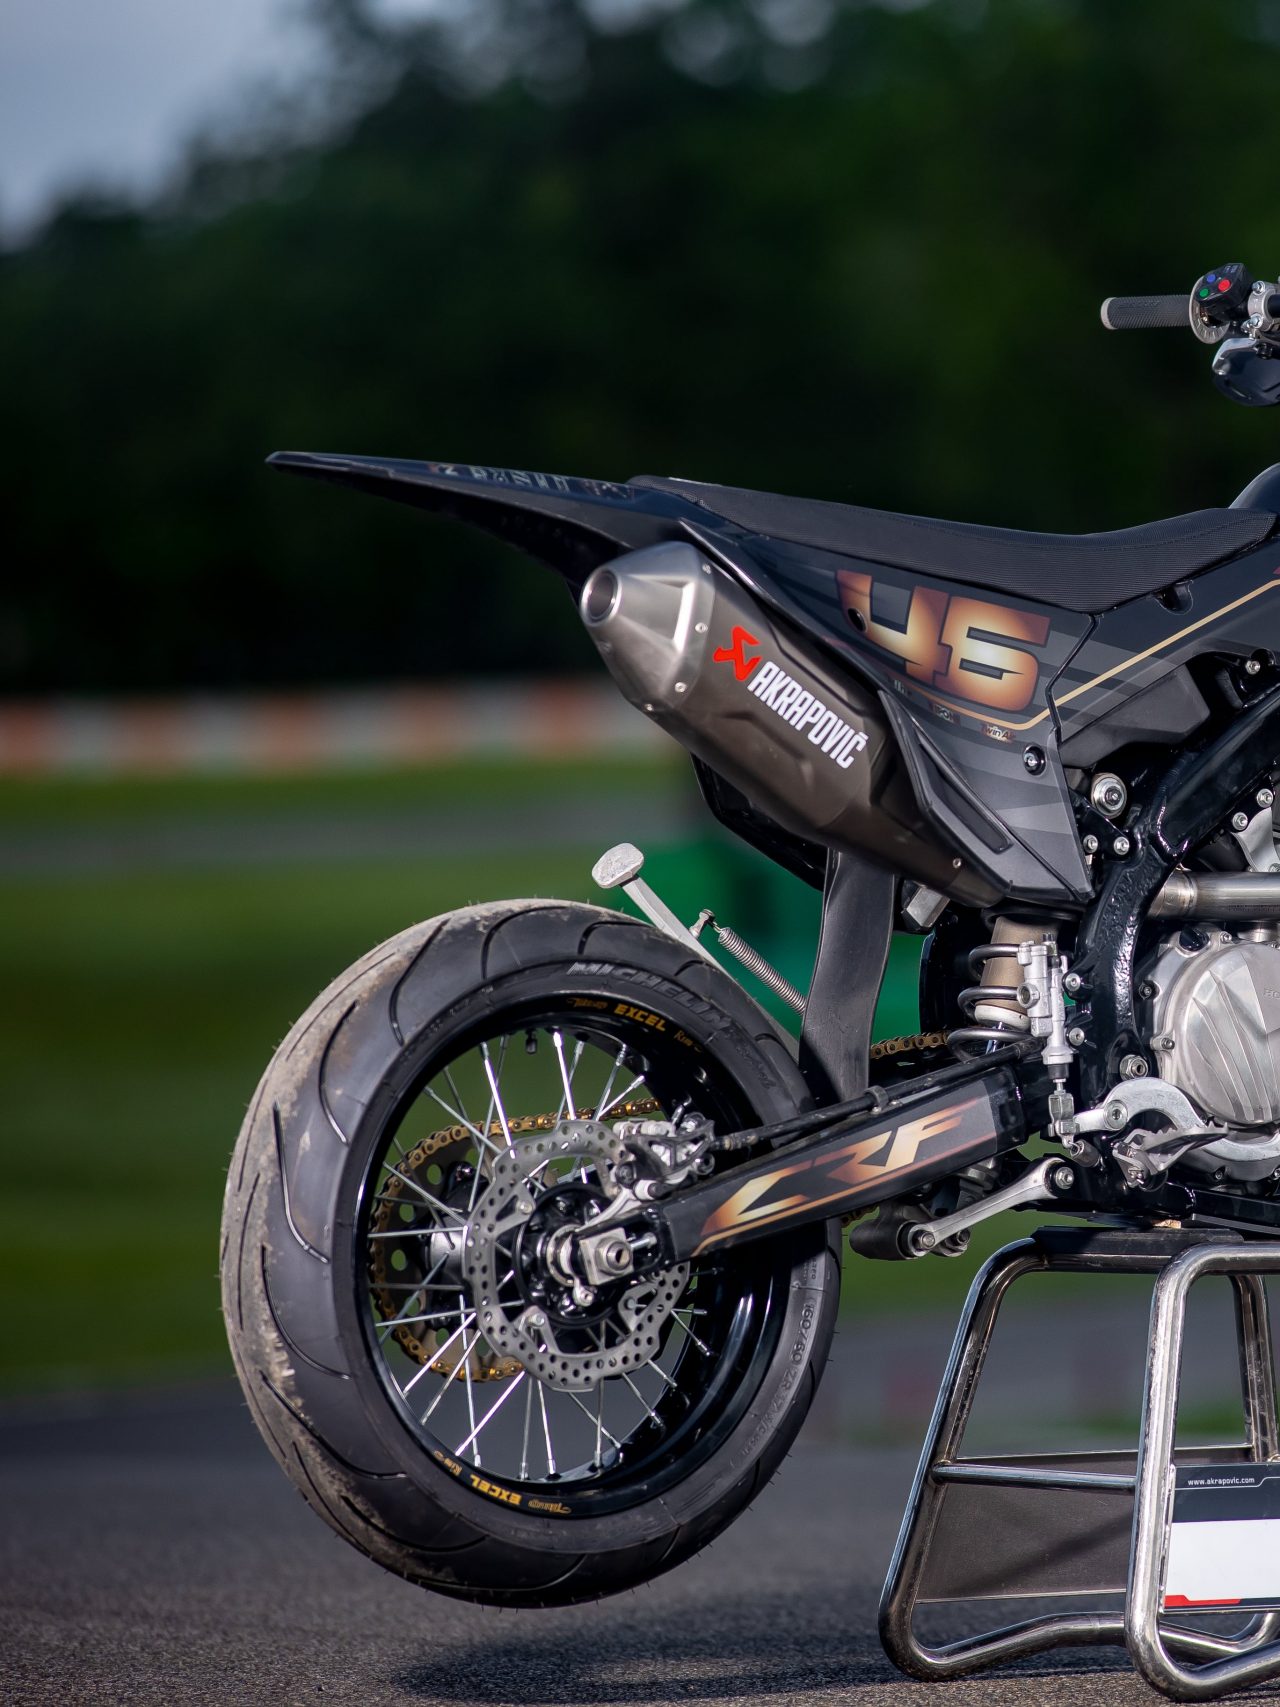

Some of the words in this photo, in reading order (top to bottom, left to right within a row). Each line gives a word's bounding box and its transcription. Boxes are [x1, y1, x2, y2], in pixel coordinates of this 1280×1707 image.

[836, 569, 1051, 712] 46
[566, 961, 733, 1030] MICHELIN
[614, 1003, 666, 1032] EXCEL
[700, 1098, 978, 1236] CRF
[791, 1302, 816, 1366] 160/60
[469, 1474, 523, 1506] EXCEL
[1187, 1476, 1255, 1487] www.akrapovic.com
